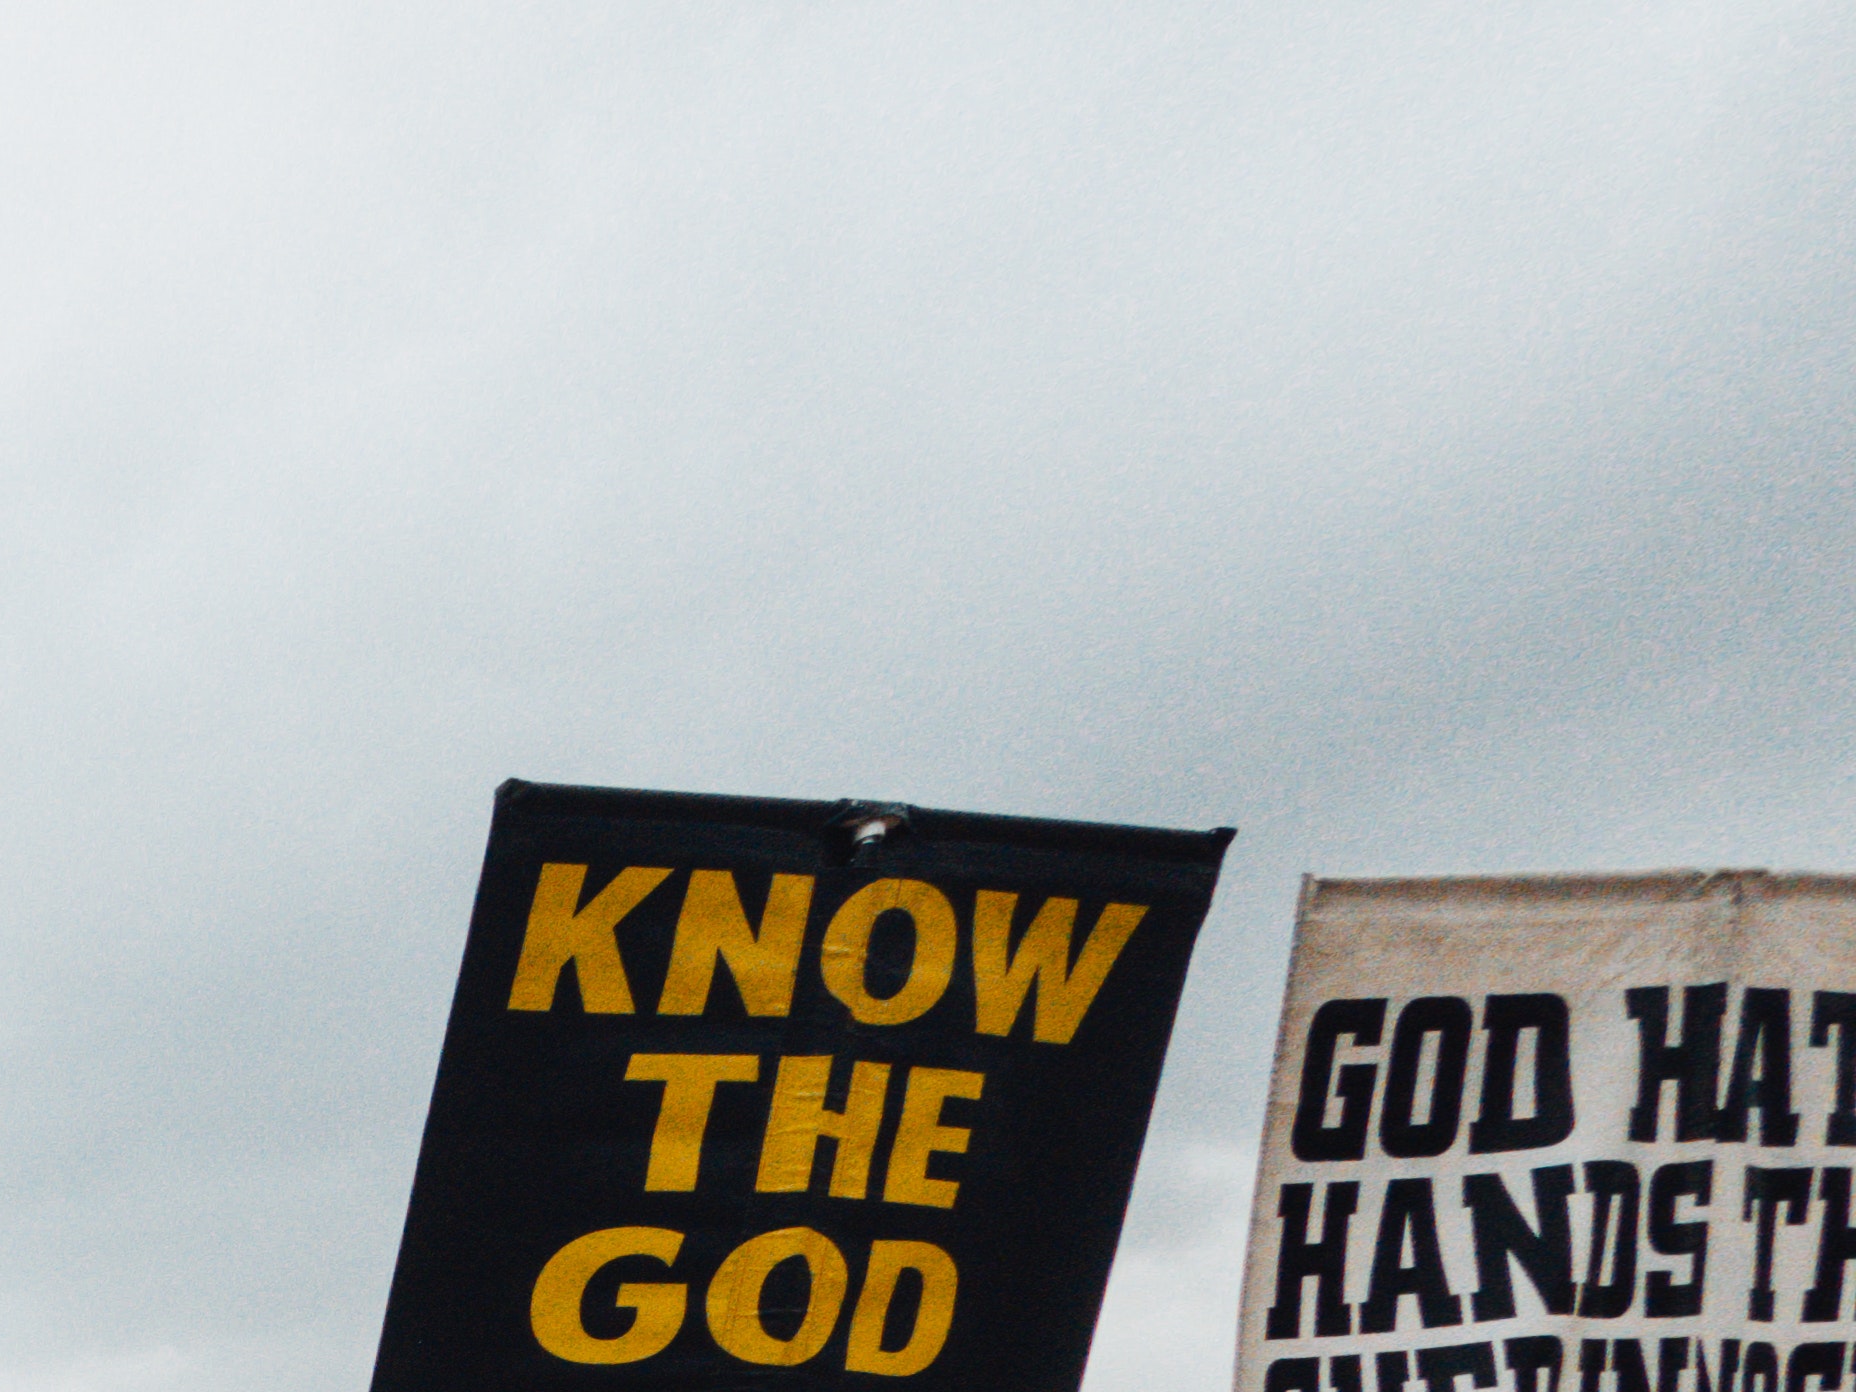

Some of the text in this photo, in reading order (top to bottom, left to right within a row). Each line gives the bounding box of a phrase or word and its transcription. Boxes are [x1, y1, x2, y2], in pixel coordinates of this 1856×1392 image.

[506, 861, 1149, 1045] KNOW
[623, 1053, 985, 1210] THE
[1291, 994, 1574, 1162] GOD
[529, 1225, 960, 1378] GOD
[1264, 1159, 1714, 1342] HANDS
